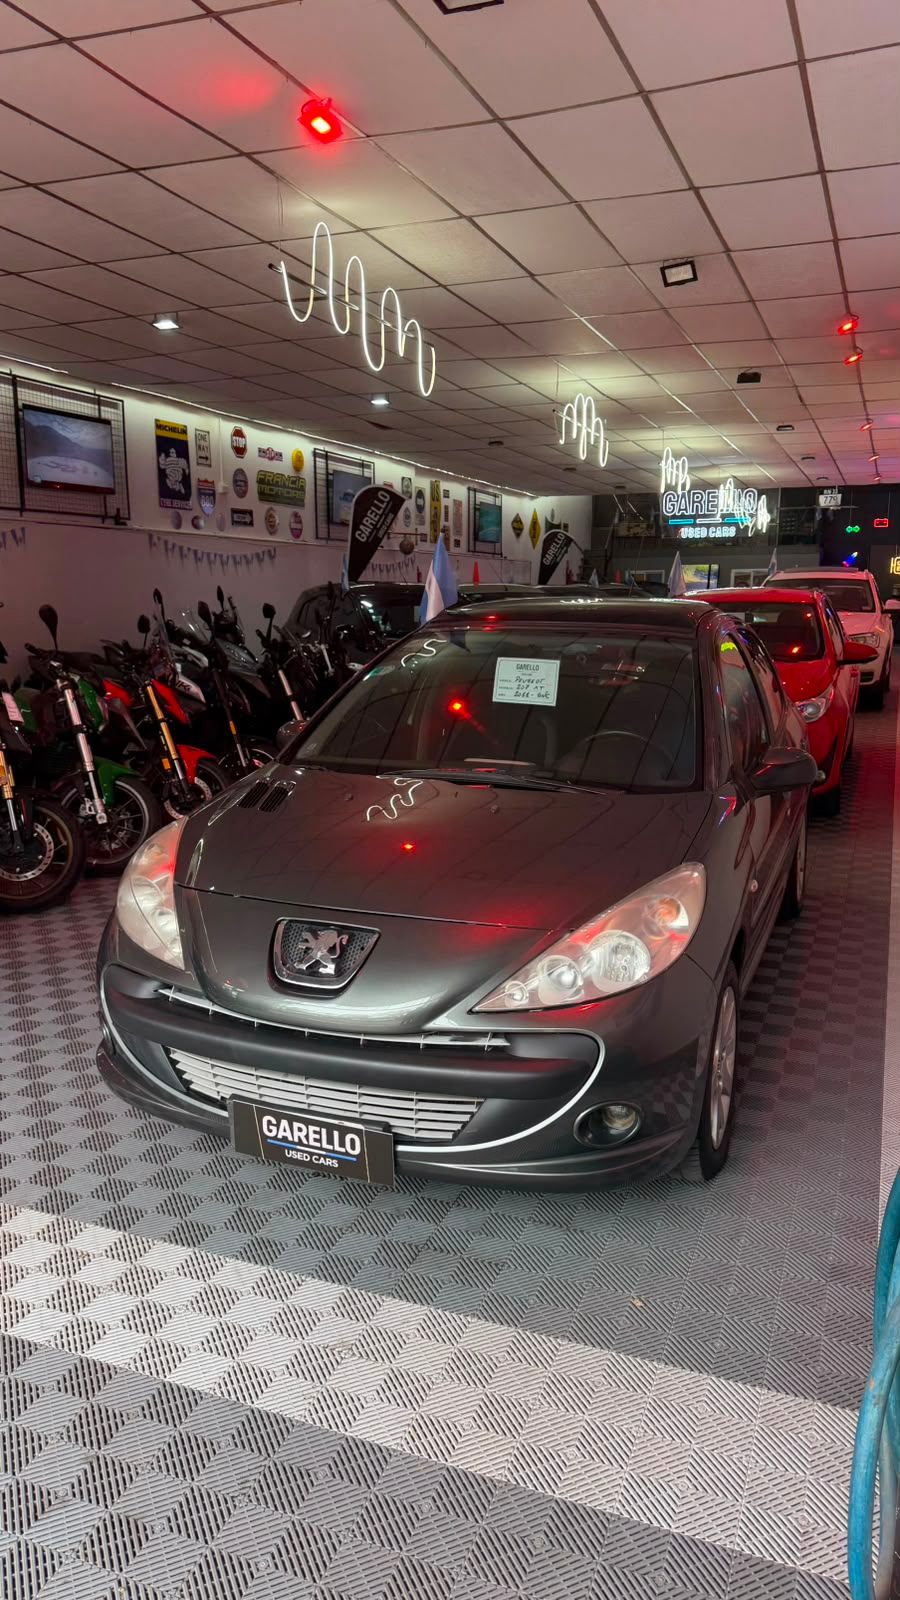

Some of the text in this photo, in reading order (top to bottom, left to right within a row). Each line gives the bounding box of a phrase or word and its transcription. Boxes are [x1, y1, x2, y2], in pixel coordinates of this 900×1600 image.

[156, 423, 187, 435] MICHELIN
[197, 432, 208, 442] ONE
[232, 436, 246, 448] STOP
[198, 443, 209, 454] WAY
[257, 471, 306, 488] FRANCIA
[355, 490, 390, 542] GARELLO
[680, 526, 737, 539] USED CARS
[542, 533, 565, 566] GARELLO
[262, 1115, 361, 1156] GARELLO
[285, 1149, 339, 1168] USED CARS
